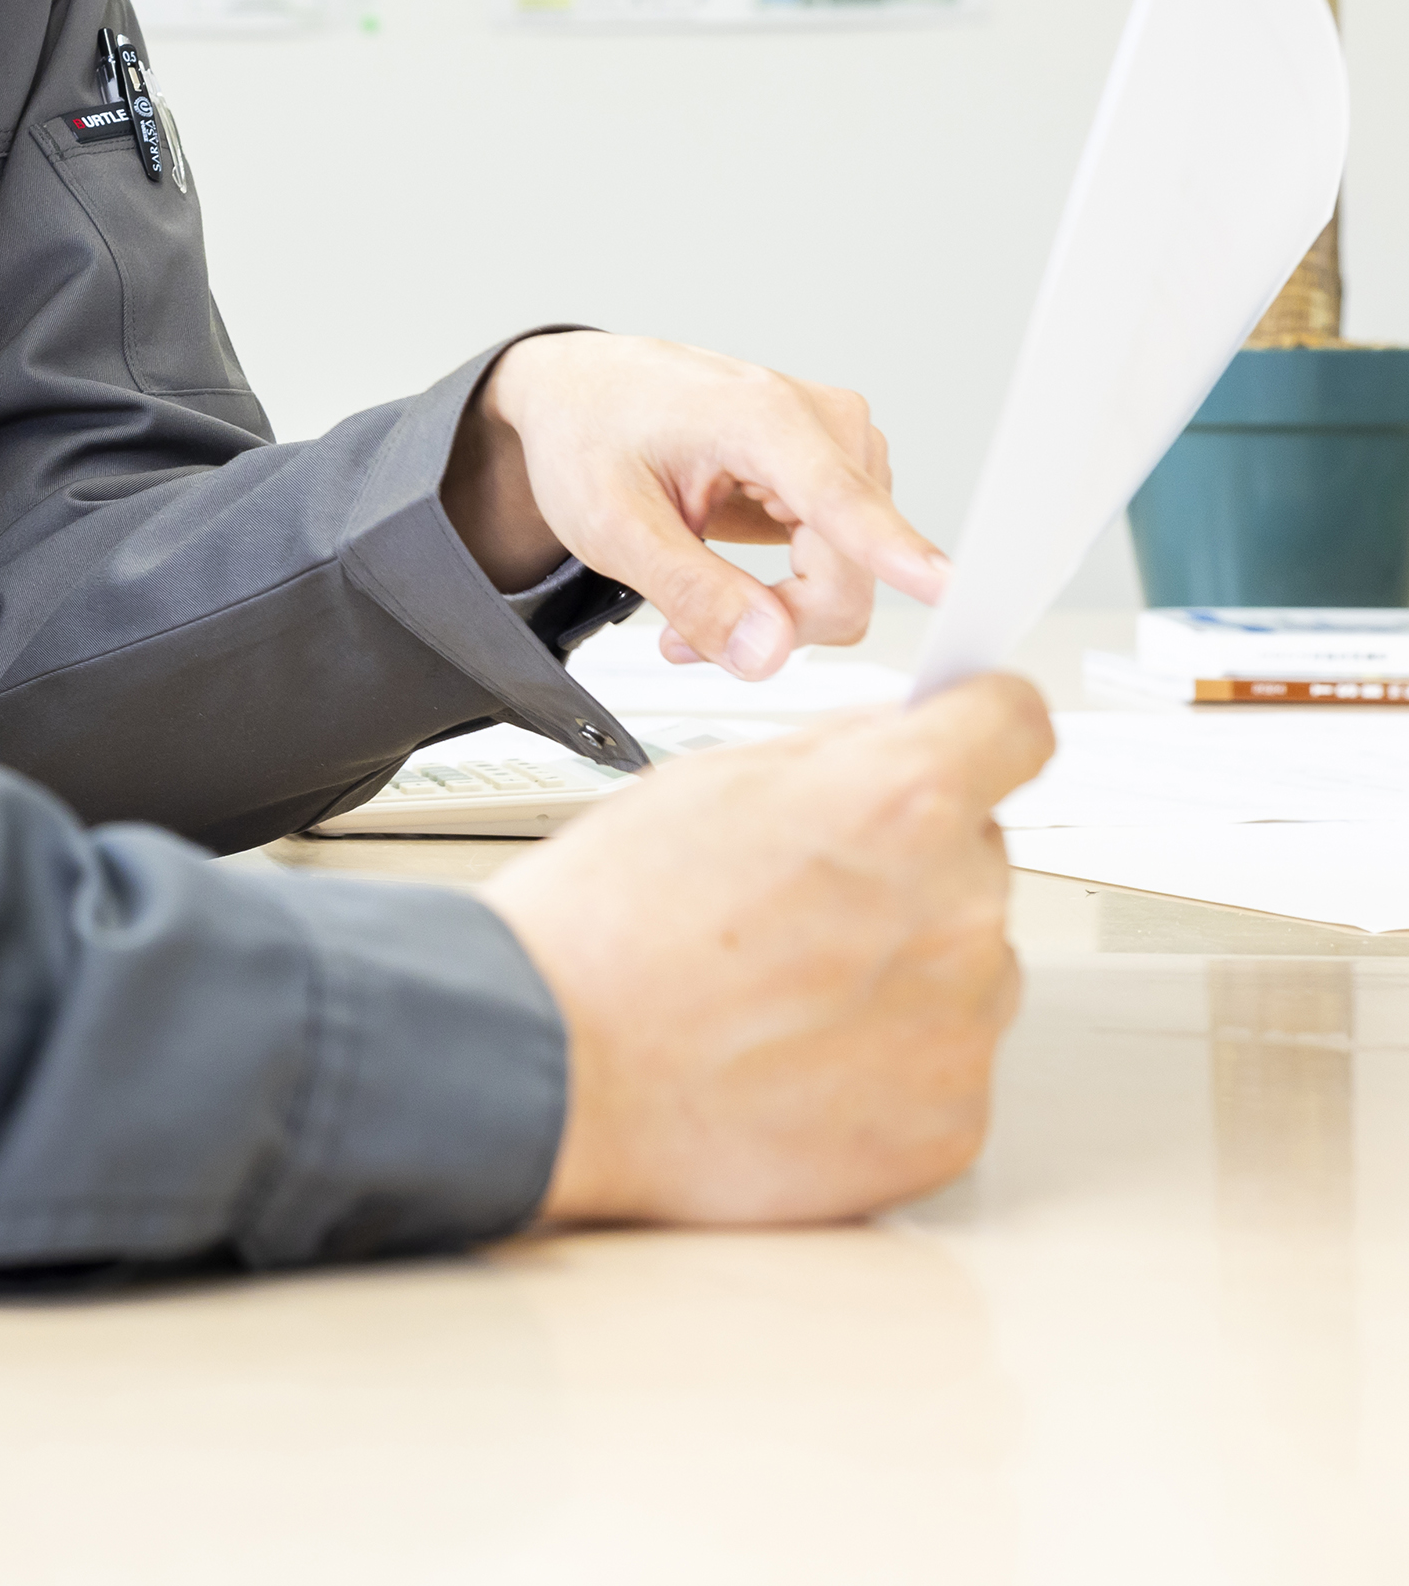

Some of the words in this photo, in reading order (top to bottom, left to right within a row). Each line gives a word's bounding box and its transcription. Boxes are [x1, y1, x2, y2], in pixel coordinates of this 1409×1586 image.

[122, 50, 137, 64] 0.5
[72, 108, 129, 129] BURTLE
[146, 119, 162, 172] SARASA
